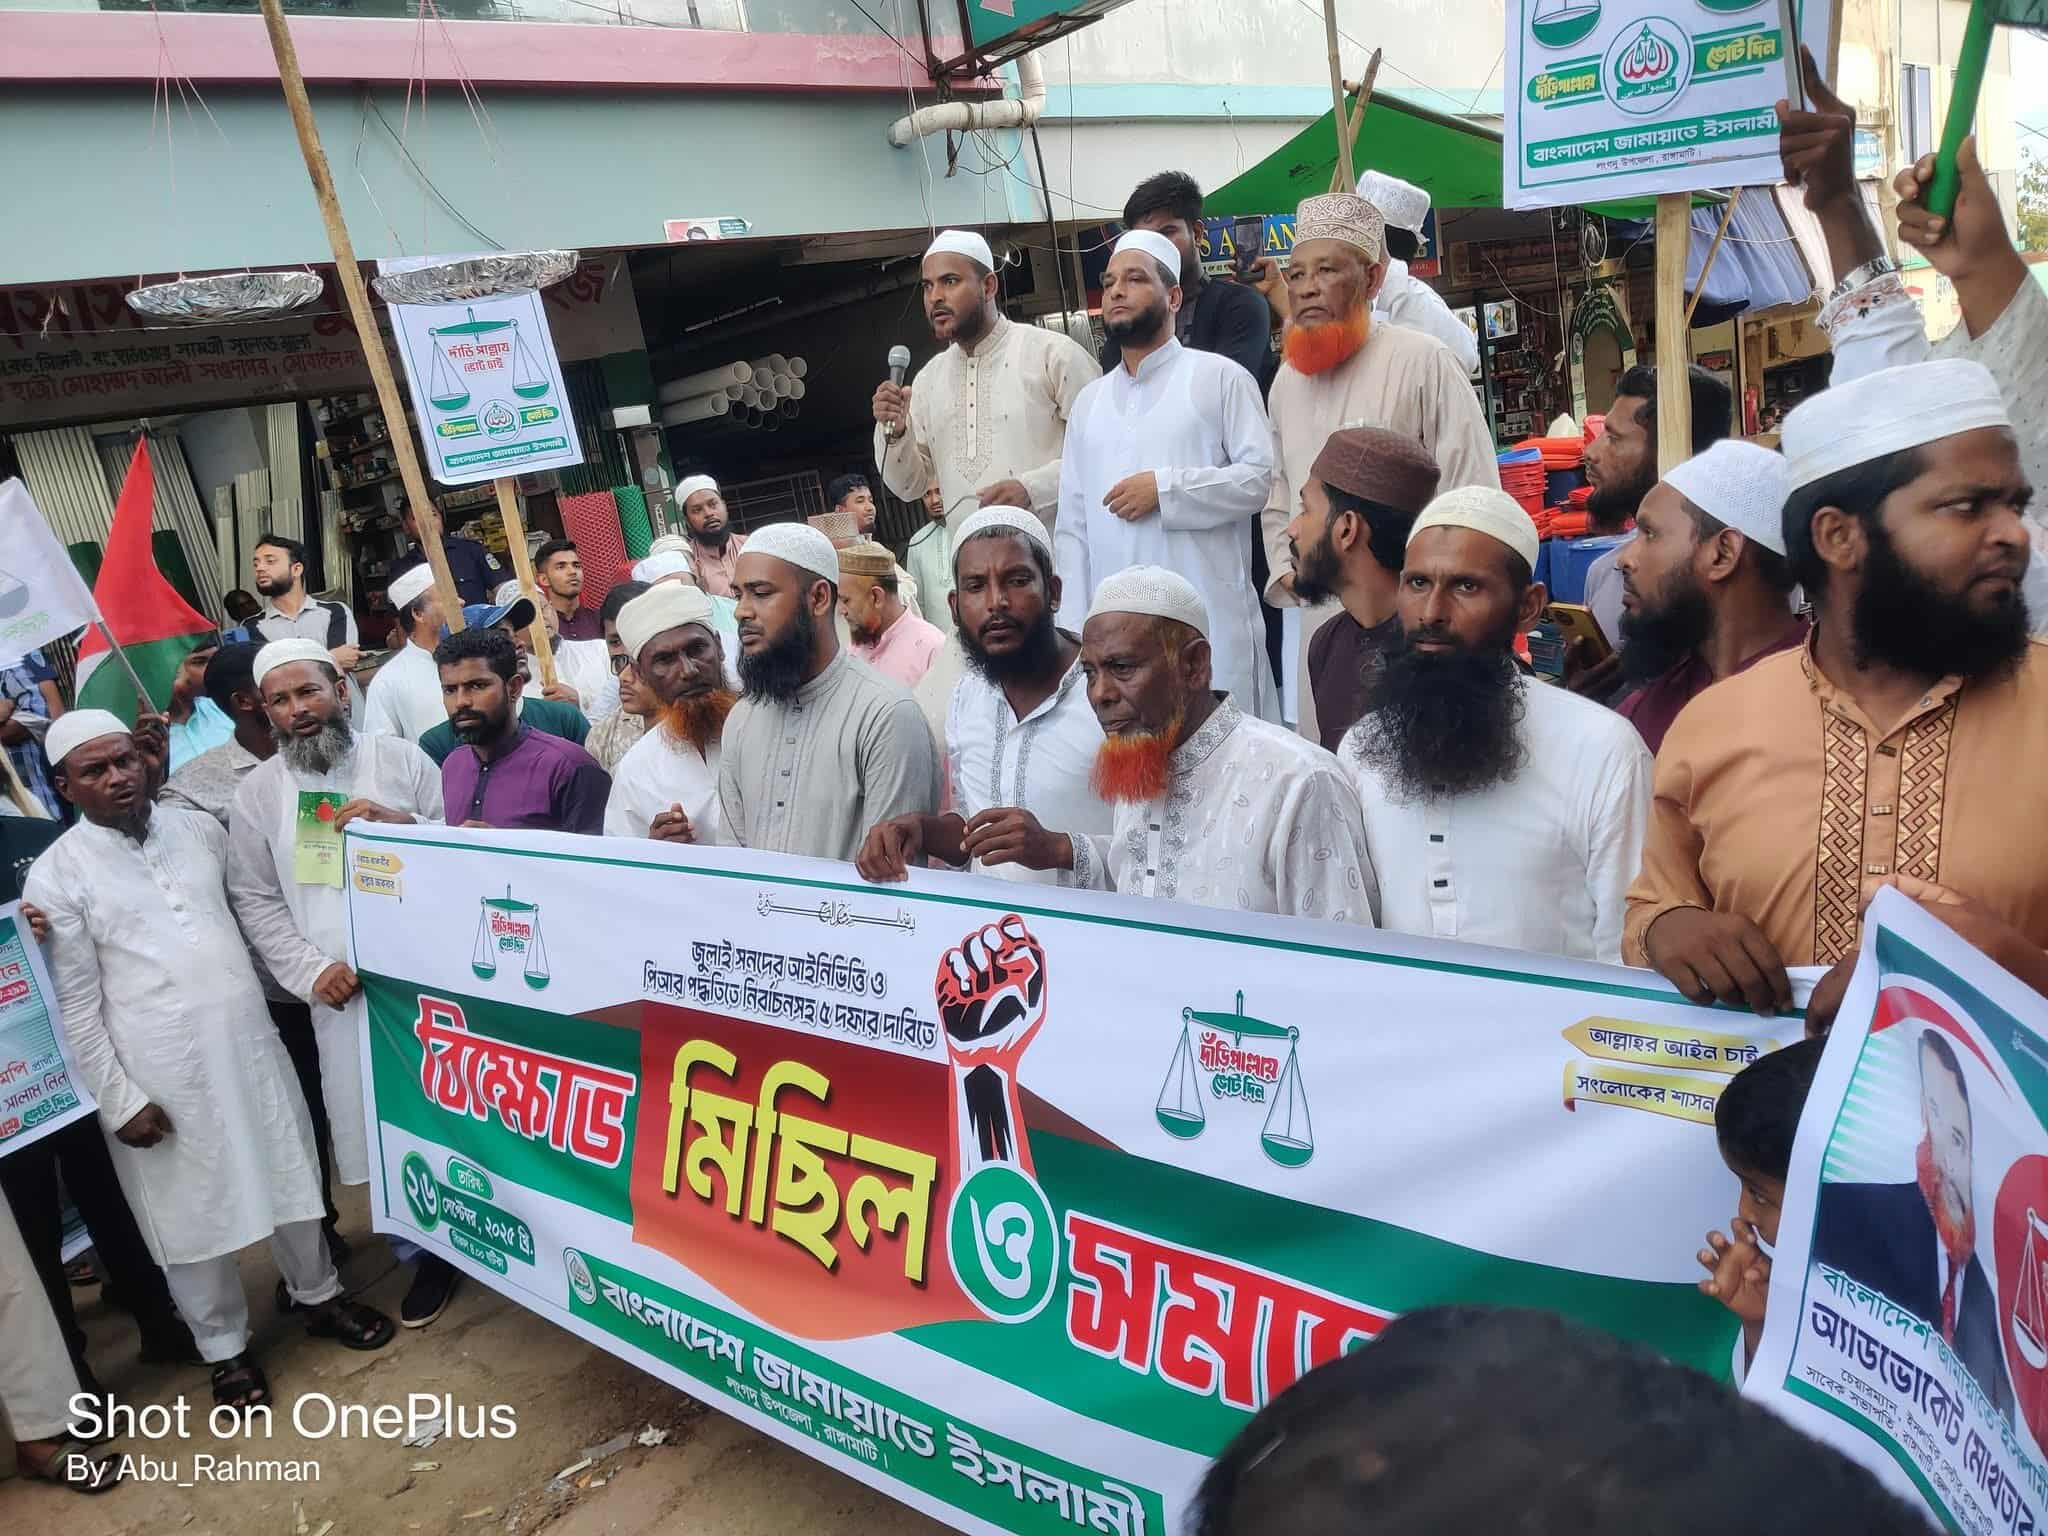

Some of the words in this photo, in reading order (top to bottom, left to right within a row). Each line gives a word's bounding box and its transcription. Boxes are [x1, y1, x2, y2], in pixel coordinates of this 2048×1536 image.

[1707, 39, 1746, 71] ভোট
[1746, 34, 1776, 60] দিন
[1533, 139, 1609, 163] বাংলাদেশ
[1613, 126, 1699, 151] জামায়াতে
[1702, 108, 1778, 137] ইসলামী
[690, 938, 732, 973] জুলাই
[734, 948, 784, 978] সনদের
[788, 951, 867, 994] আইনিভিত্তি
[871, 971, 886, 997] ও
[642, 960, 684, 998] পিআর
[687, 968, 740, 1008] পদ্ধতিতে
[742, 977, 817, 1027] নির্বাচনসহ
[819, 1005, 833, 1027] ৫
[834, 1004, 882, 1039] দফার
[883, 1006, 938, 1050] দাবিতে
[1588, 1027, 1660, 1053] আল্লাহর
[1664, 1039, 1718, 1061] আইন
[1723, 1044, 1760, 1065] চাই
[1212, 1073, 1241, 1098] ভোট
[1242, 1074, 1265, 1100] দিন
[1671, 1089, 1716, 1113] শাসন
[414, 993, 638, 1170] বিক্ষোভ
[661, 1038, 938, 1284] মিছিল
[484, 1216, 515, 1247] ২০২৫
[1817, 1261, 1936, 1351] বাংলাদেশ
[1811, 1300, 1966, 1447] অ্যাডভোকেট
[598, 1274, 745, 1374] বাংলাদেশ
[752, 1346, 935, 1458] জামায়াতে
[945, 1421, 1146, 1536] ইসলামী
